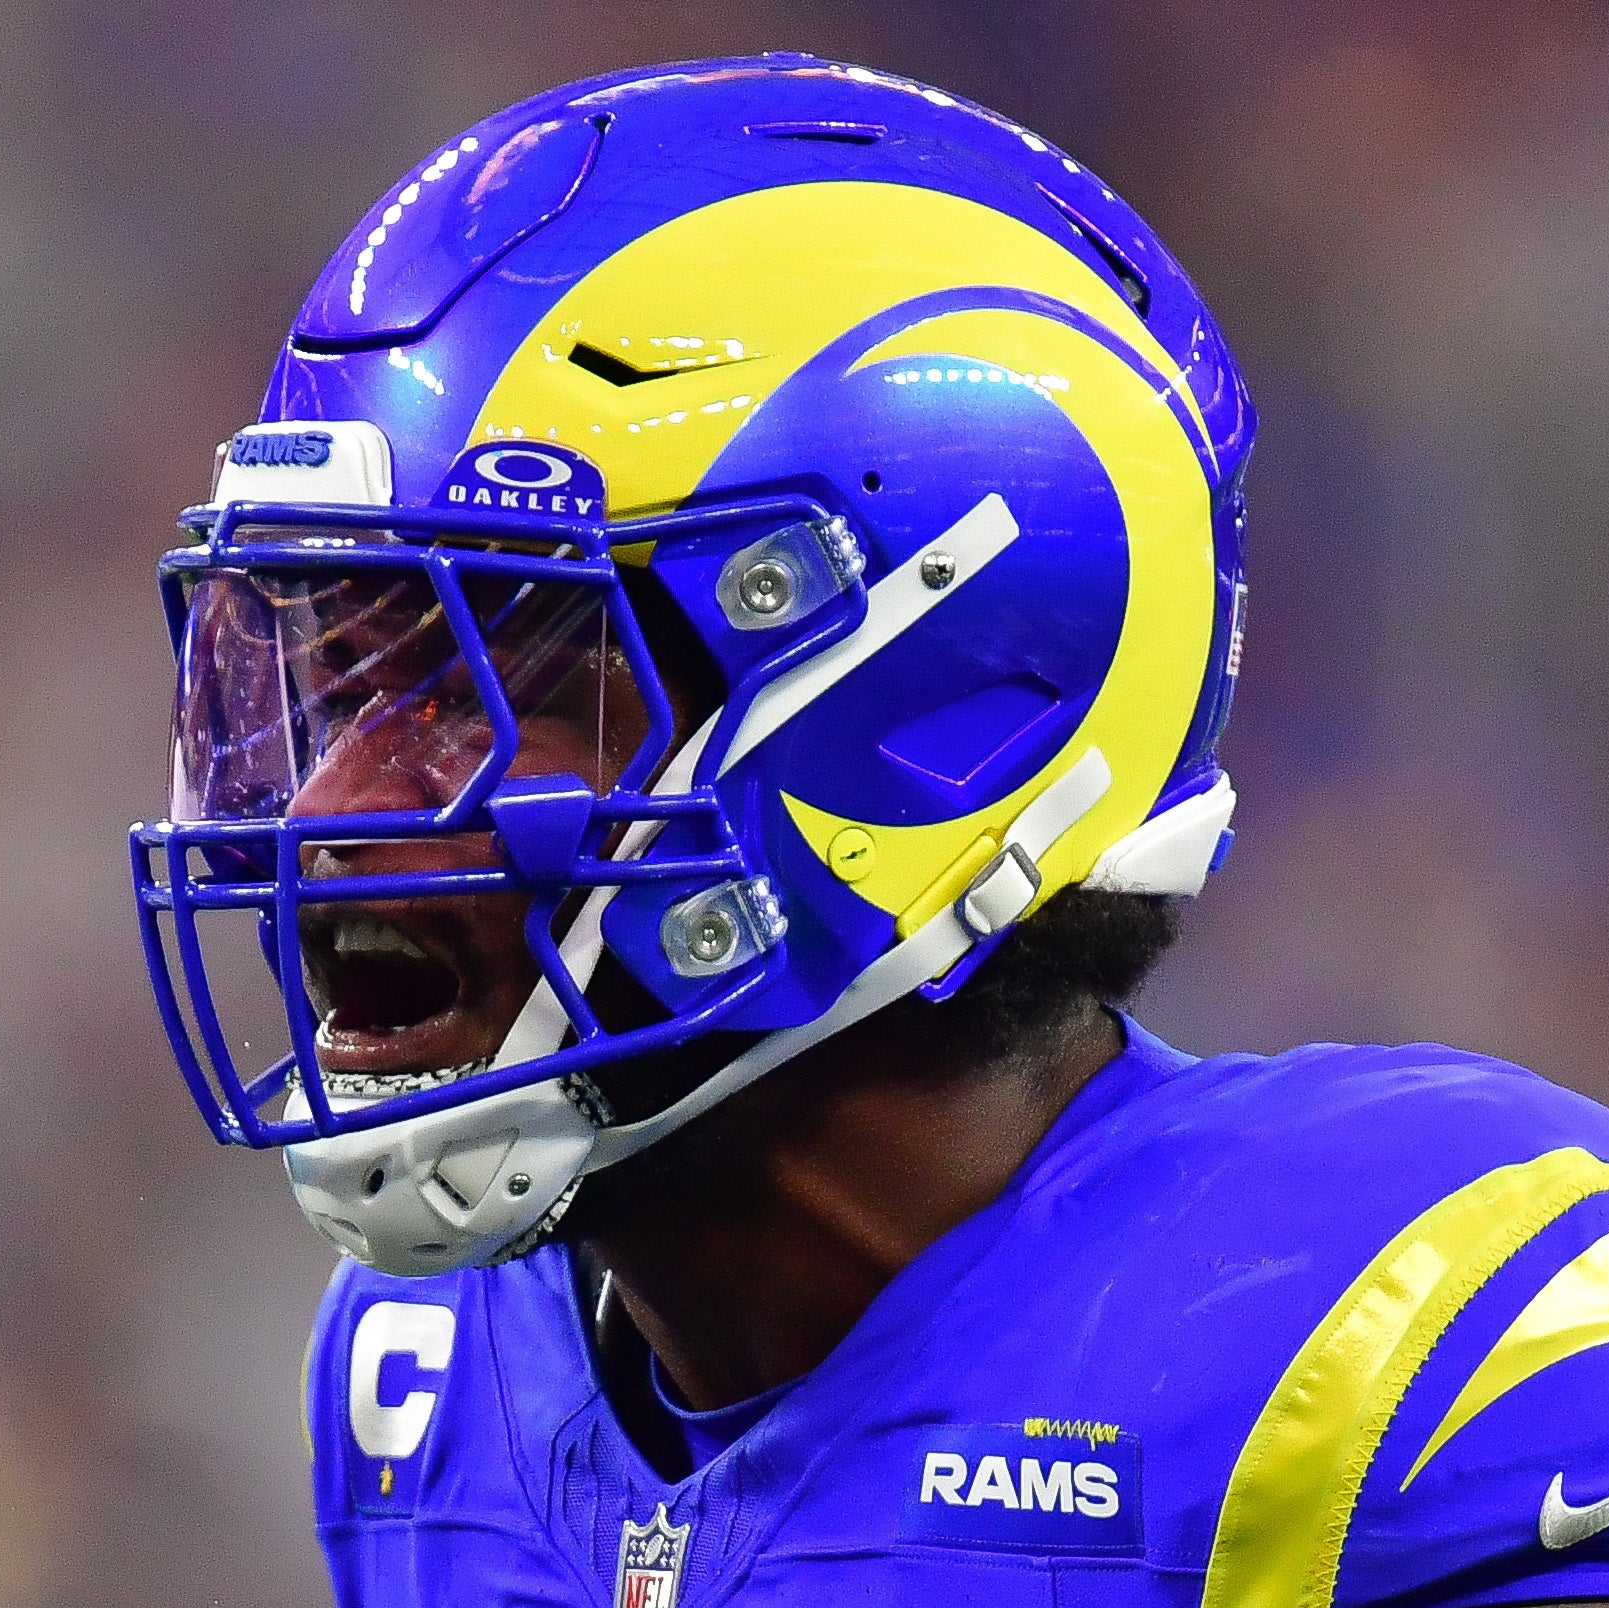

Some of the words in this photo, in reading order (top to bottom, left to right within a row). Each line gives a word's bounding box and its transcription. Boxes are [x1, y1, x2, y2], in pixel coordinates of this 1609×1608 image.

[230, 430, 334, 468] RAMS
[447, 483, 594, 516] OAKLEY
[349, 1300, 456, 1458] C
[918, 1451, 1121, 1519] RAMS
